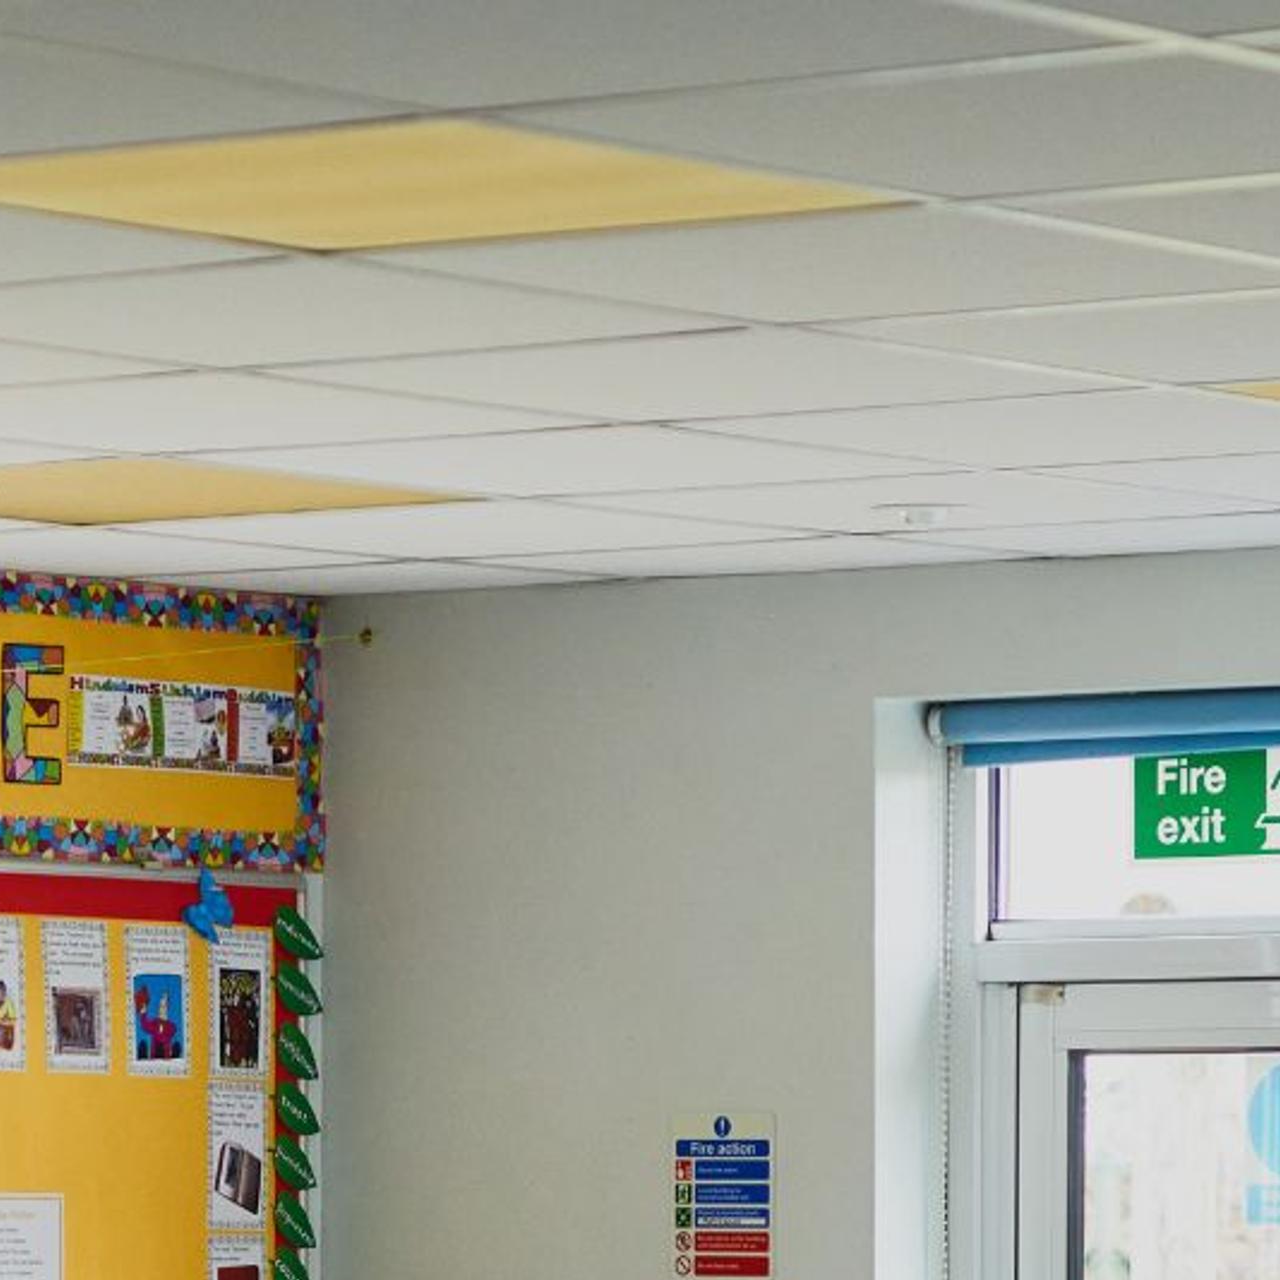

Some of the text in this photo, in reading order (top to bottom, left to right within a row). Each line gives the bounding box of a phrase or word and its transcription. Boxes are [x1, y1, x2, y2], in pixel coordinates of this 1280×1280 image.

[1157, 758, 1227, 795] Fire
[1157, 806, 1227, 844] exit
[689, 1142, 756, 1155] Fire action
